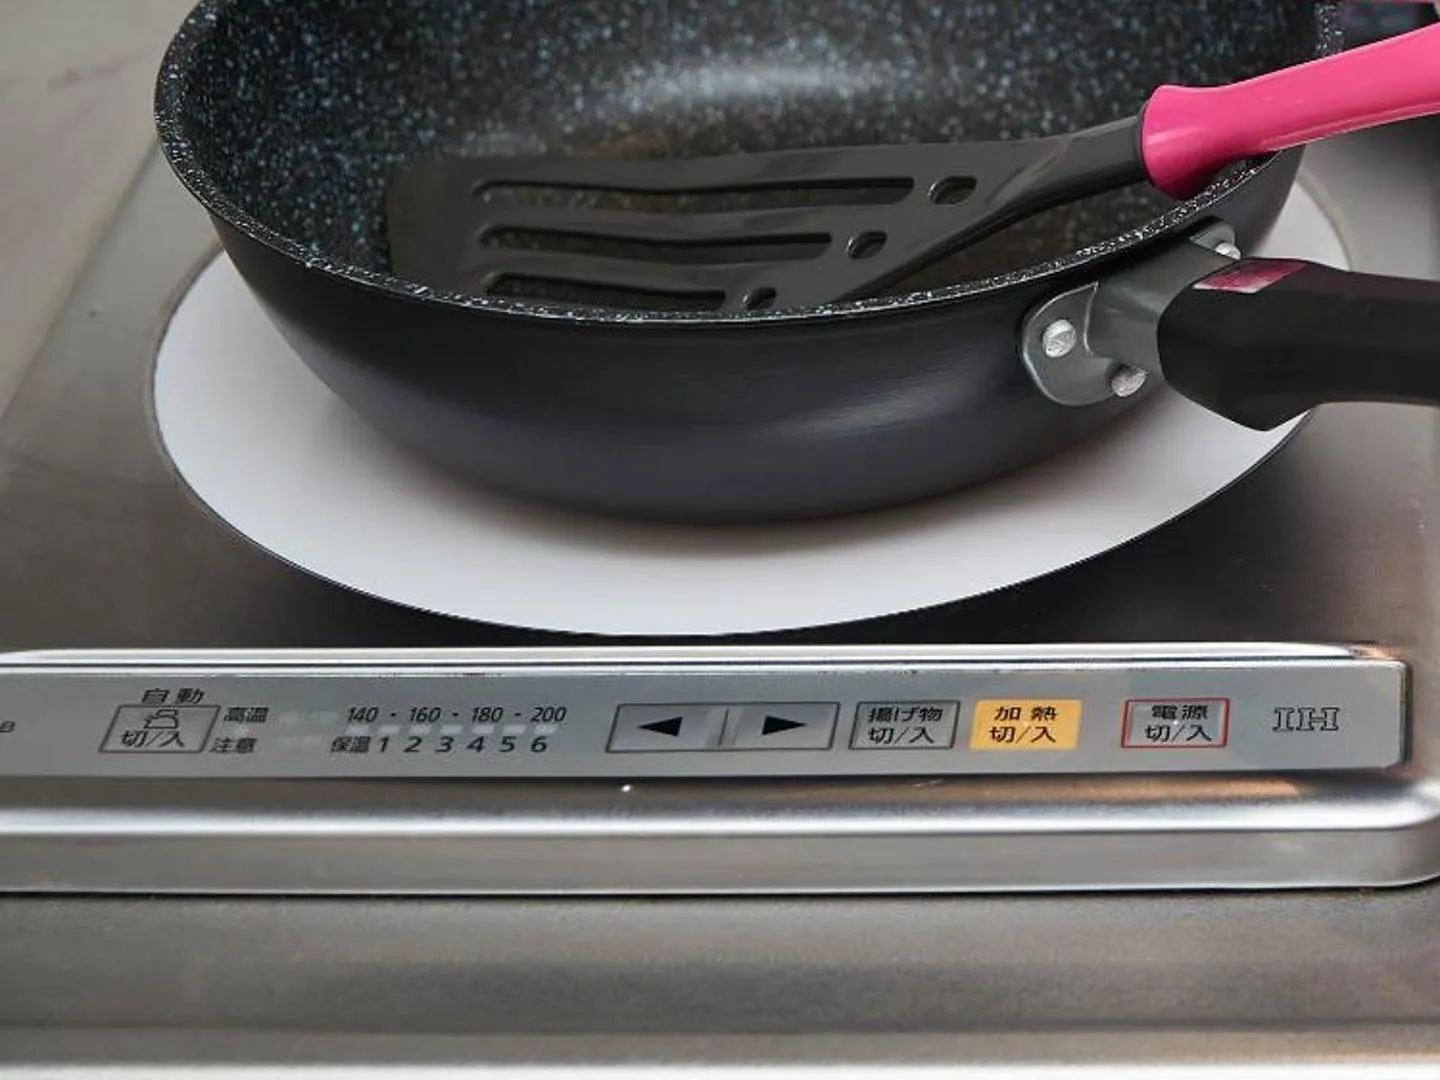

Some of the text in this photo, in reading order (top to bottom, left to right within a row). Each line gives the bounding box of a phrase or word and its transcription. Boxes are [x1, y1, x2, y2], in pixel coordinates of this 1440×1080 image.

[141, 688, 206, 705] 自動
[224, 706, 270, 723] 高温
[349, 706, 568, 723] 140 160 180 200
[867, 706, 943, 723] 揚げ物
[994, 705, 1059, 722] 加熱
[1151, 704, 1209, 721] 電源
[1272, 707, 1340, 732] IH
[120, 731, 186, 749] 切/入
[867, 726, 935, 744] 切/入
[989, 726, 1057, 744] 切/入
[1145, 724, 1212, 742] 切/入
[209, 737, 258, 754] 注意
[379, 735, 390, 754] 1
[403, 735, 423, 754] 2
[435, 735, 454, 754] 3
[466, 735, 485, 754] 4
[499, 735, 518, 754] 5
[530, 735, 548, 754] 6
